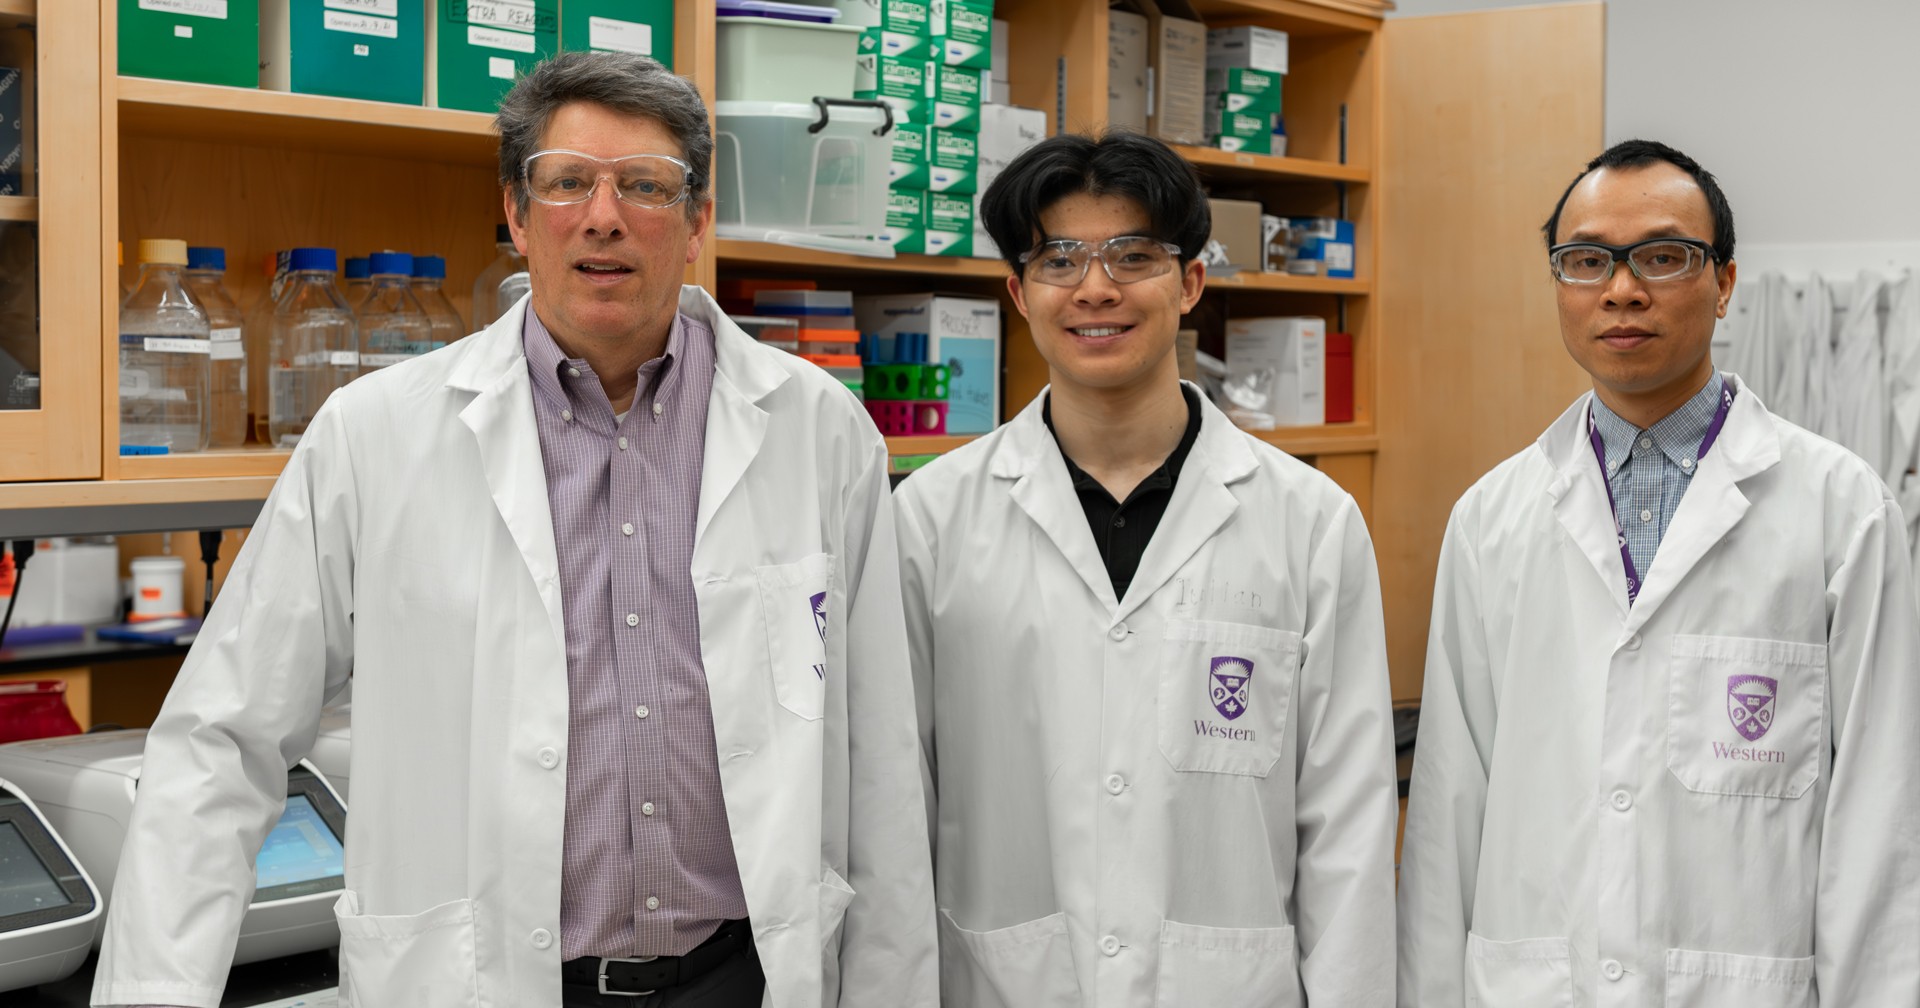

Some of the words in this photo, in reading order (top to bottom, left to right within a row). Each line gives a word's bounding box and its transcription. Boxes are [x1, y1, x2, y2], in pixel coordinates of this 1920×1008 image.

[452, 2, 497, 21] EXTRA
[0, 70, 18, 95] AGEN
[894, 130, 922, 144] MTECH
[1193, 719, 1256, 742] Western
[1712, 741, 1785, 763] Western
